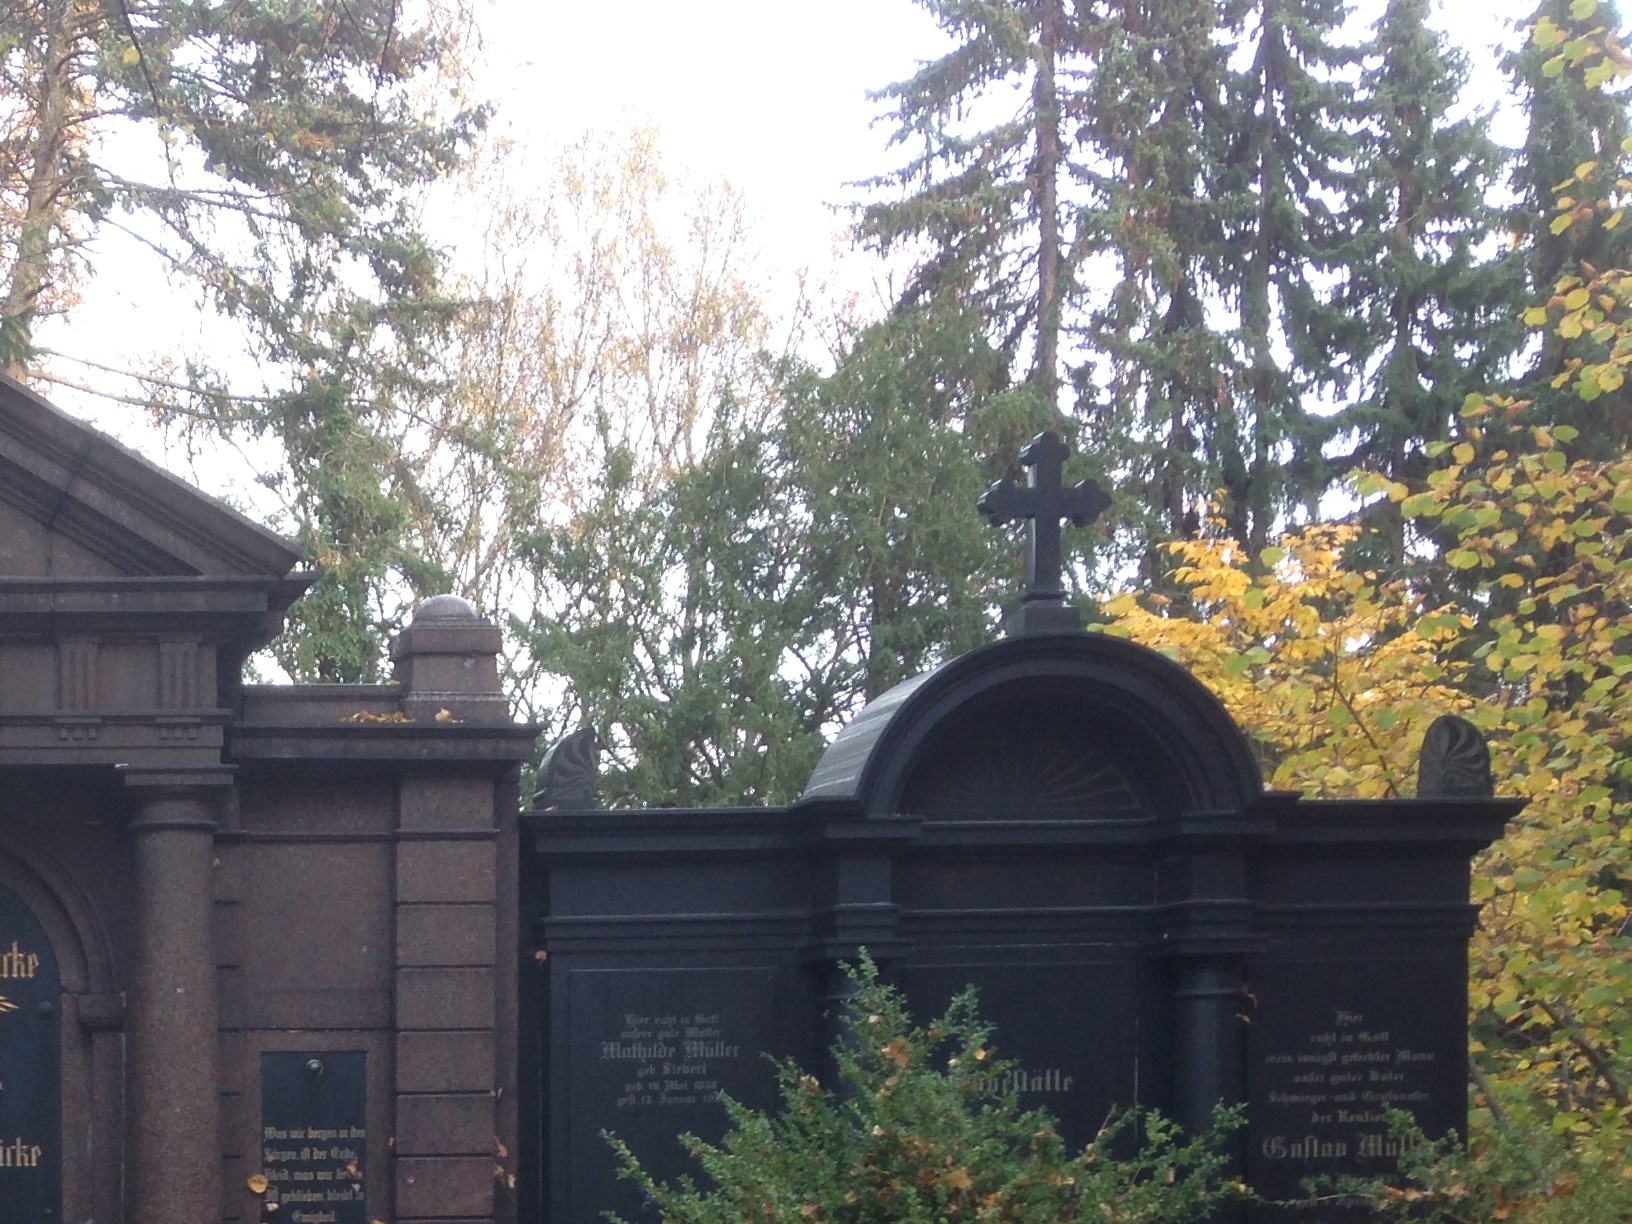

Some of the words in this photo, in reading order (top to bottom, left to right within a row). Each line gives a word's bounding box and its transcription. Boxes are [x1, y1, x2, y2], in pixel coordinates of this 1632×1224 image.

[600, 1041, 676, 1062] Mathilde
[682, 1040, 741, 1062] Müller
[1311, 1112, 1332, 1123] der
[1338, 1109, 1382, 1123] Rentie
[312, 1147, 328, 1160] der
[1262, 1134, 1347, 1159] Gustav
